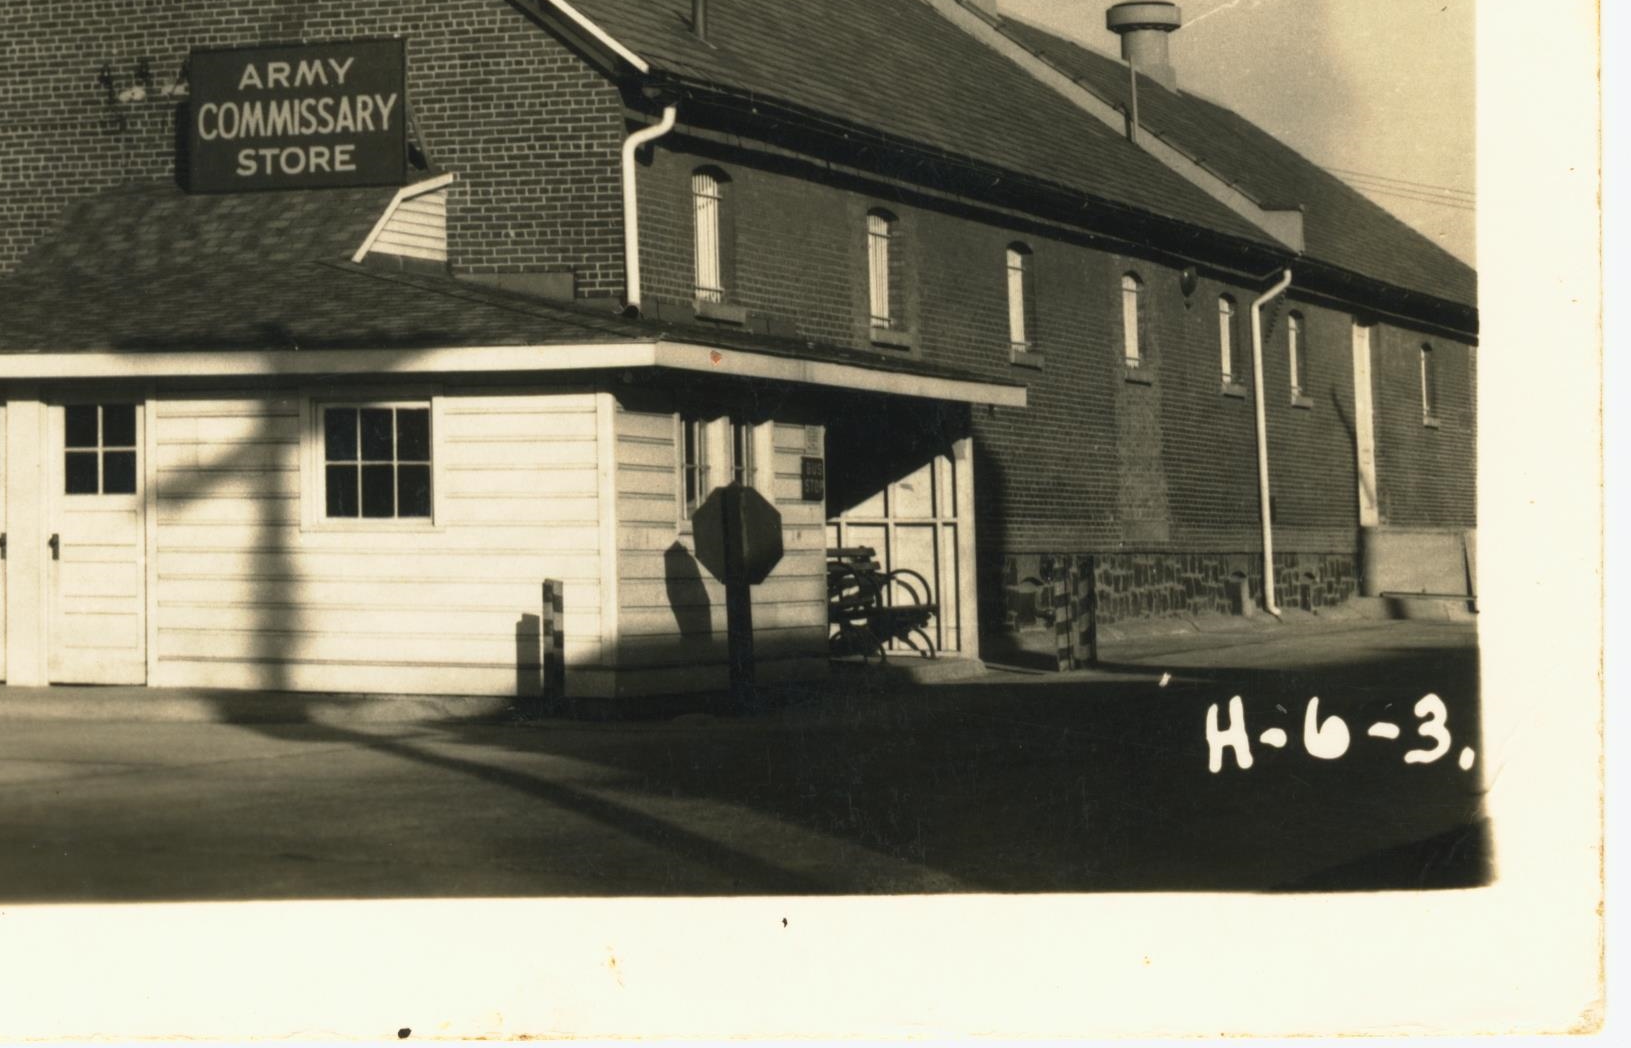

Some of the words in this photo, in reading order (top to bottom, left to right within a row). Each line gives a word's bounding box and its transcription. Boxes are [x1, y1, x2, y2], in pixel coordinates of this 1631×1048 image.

[238, 57, 354, 90] ARMY
[198, 93, 398, 140] COMMISSARY
[236, 144, 357, 176] STORE
[806, 461, 823, 476] BUS
